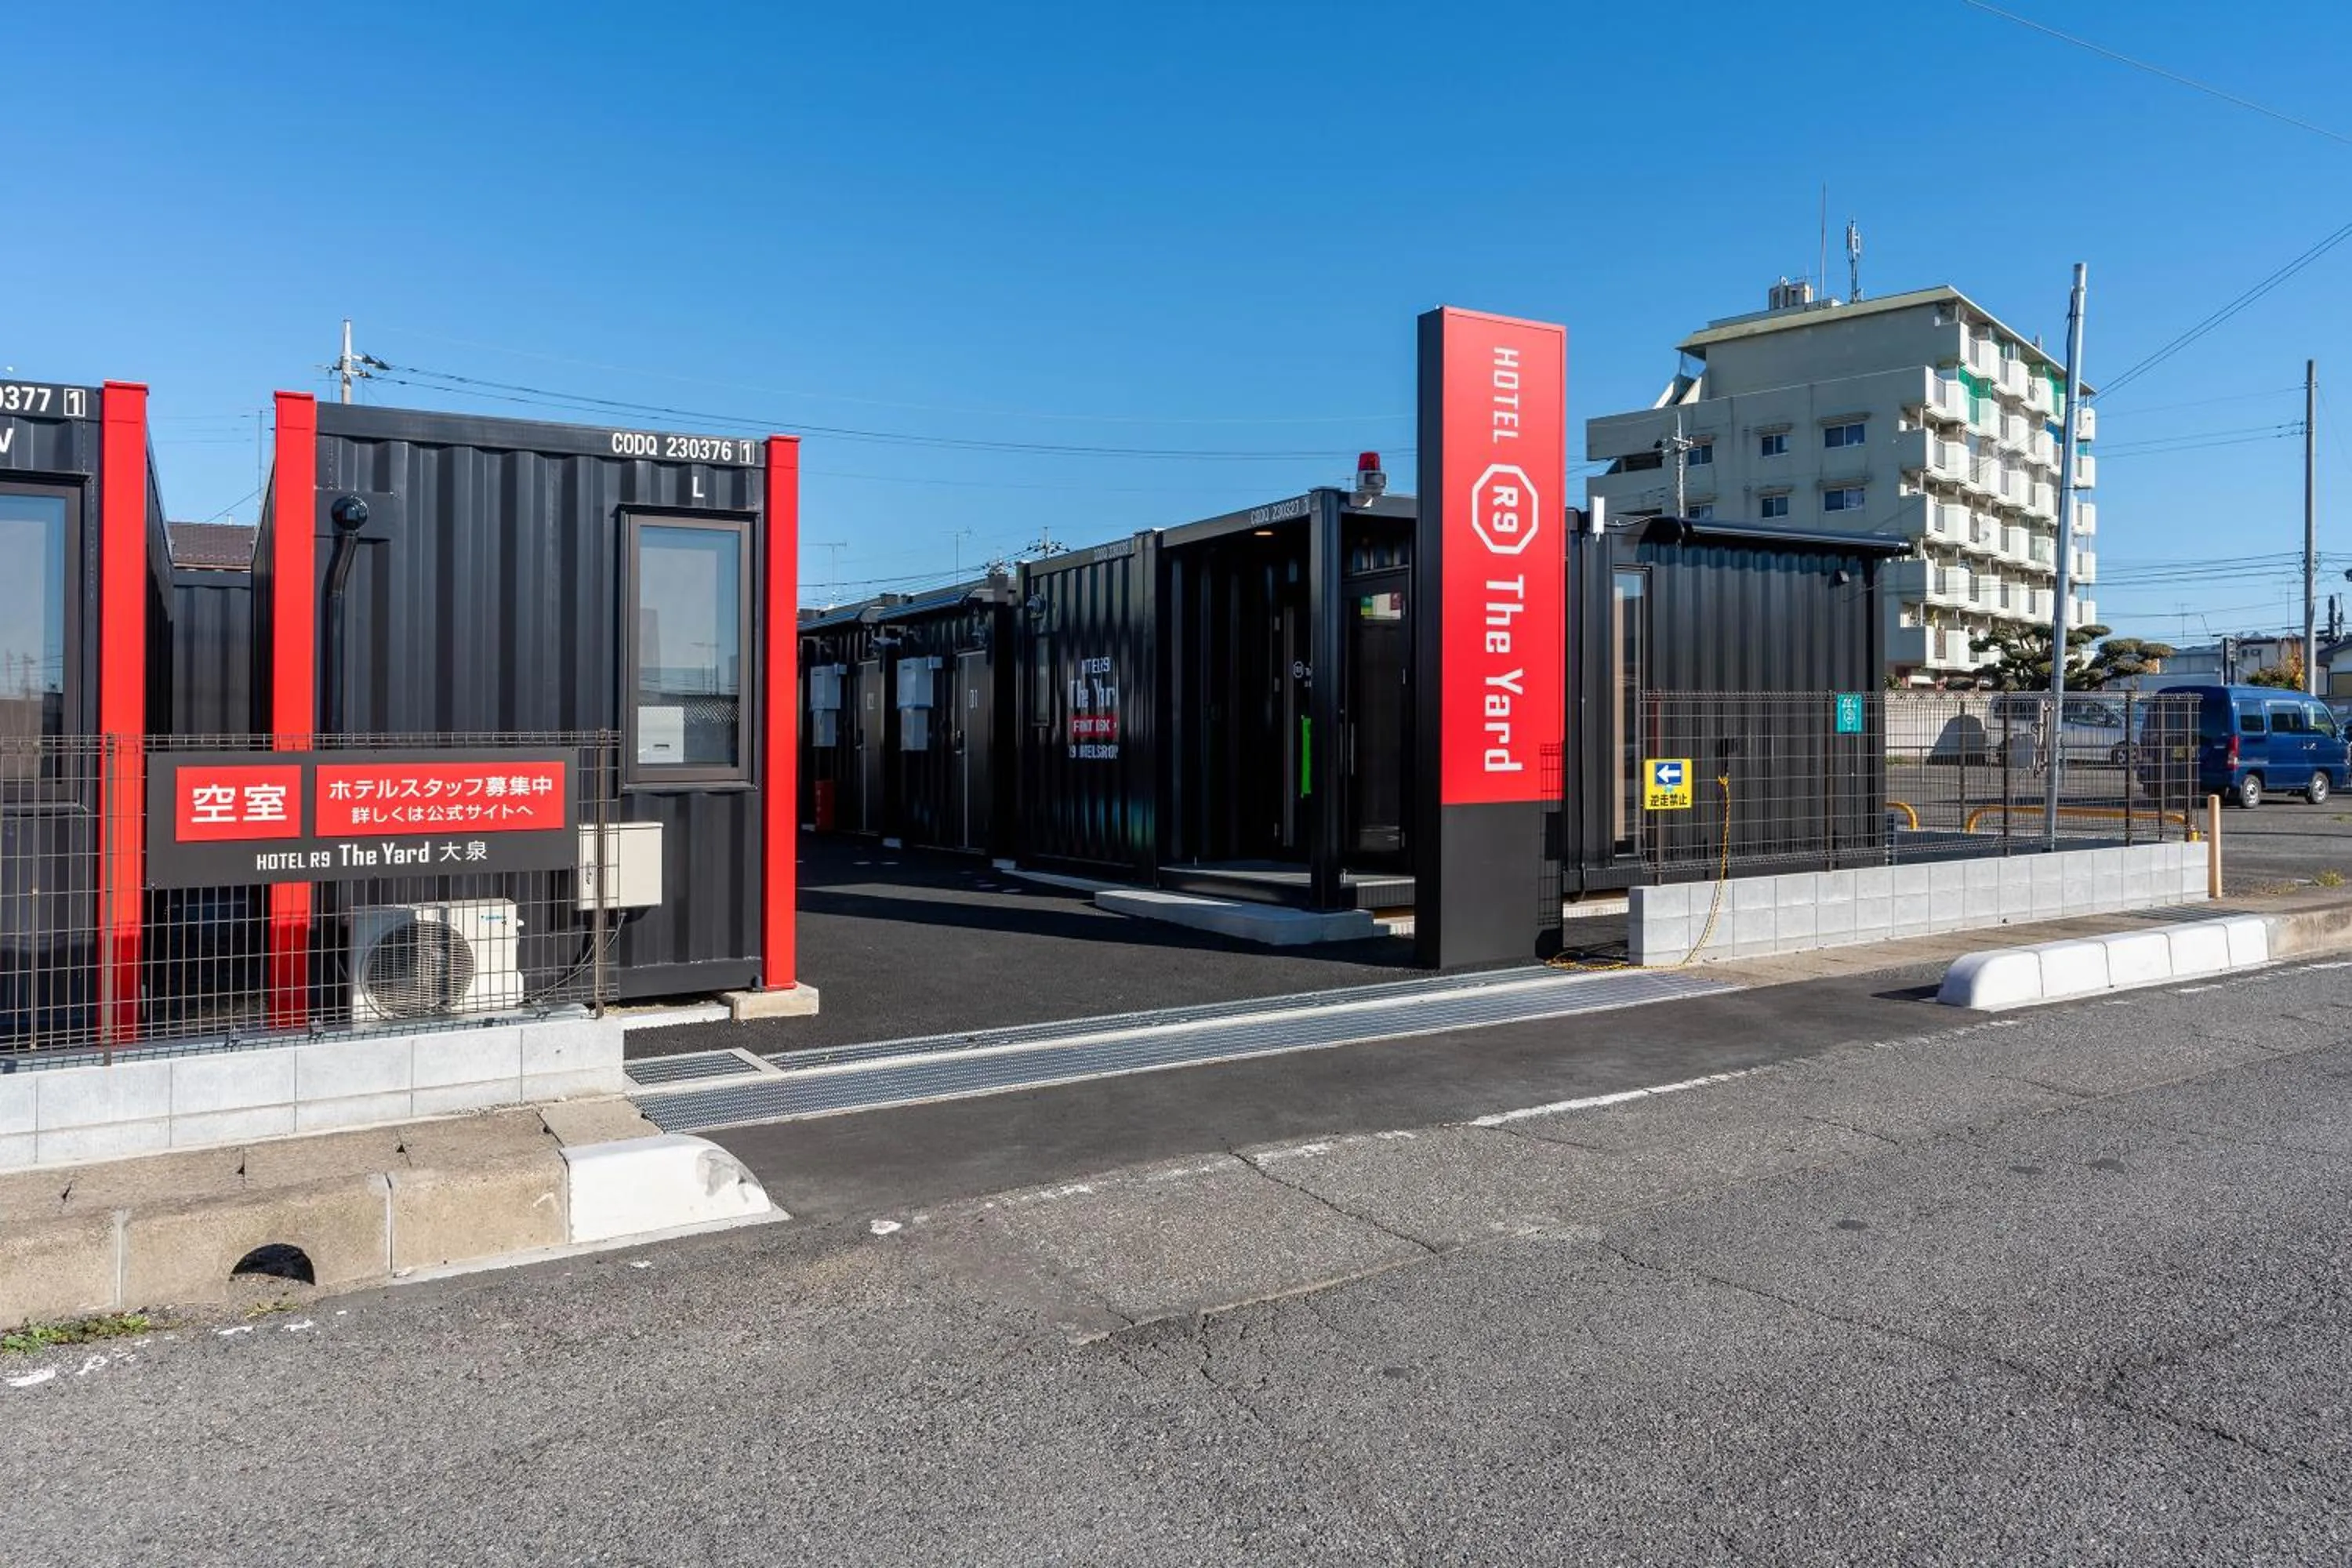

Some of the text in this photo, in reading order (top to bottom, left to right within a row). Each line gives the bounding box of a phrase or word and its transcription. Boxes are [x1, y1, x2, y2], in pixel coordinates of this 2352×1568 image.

[67, 390, 82, 416] 1
[612, 432, 753, 463] CODQ 230376 1
[692, 476, 704, 498] L
[1484, 347, 1525, 772] HOTEL R9 The Yard
[328, 775, 553, 800] ホテルスタッフ募集中
[191, 783, 288, 823] 空室
[351, 803, 534, 824] 詳しくは公式サイトへ
[256, 840, 488, 871] HOTEL R9 The Yard 大泉
